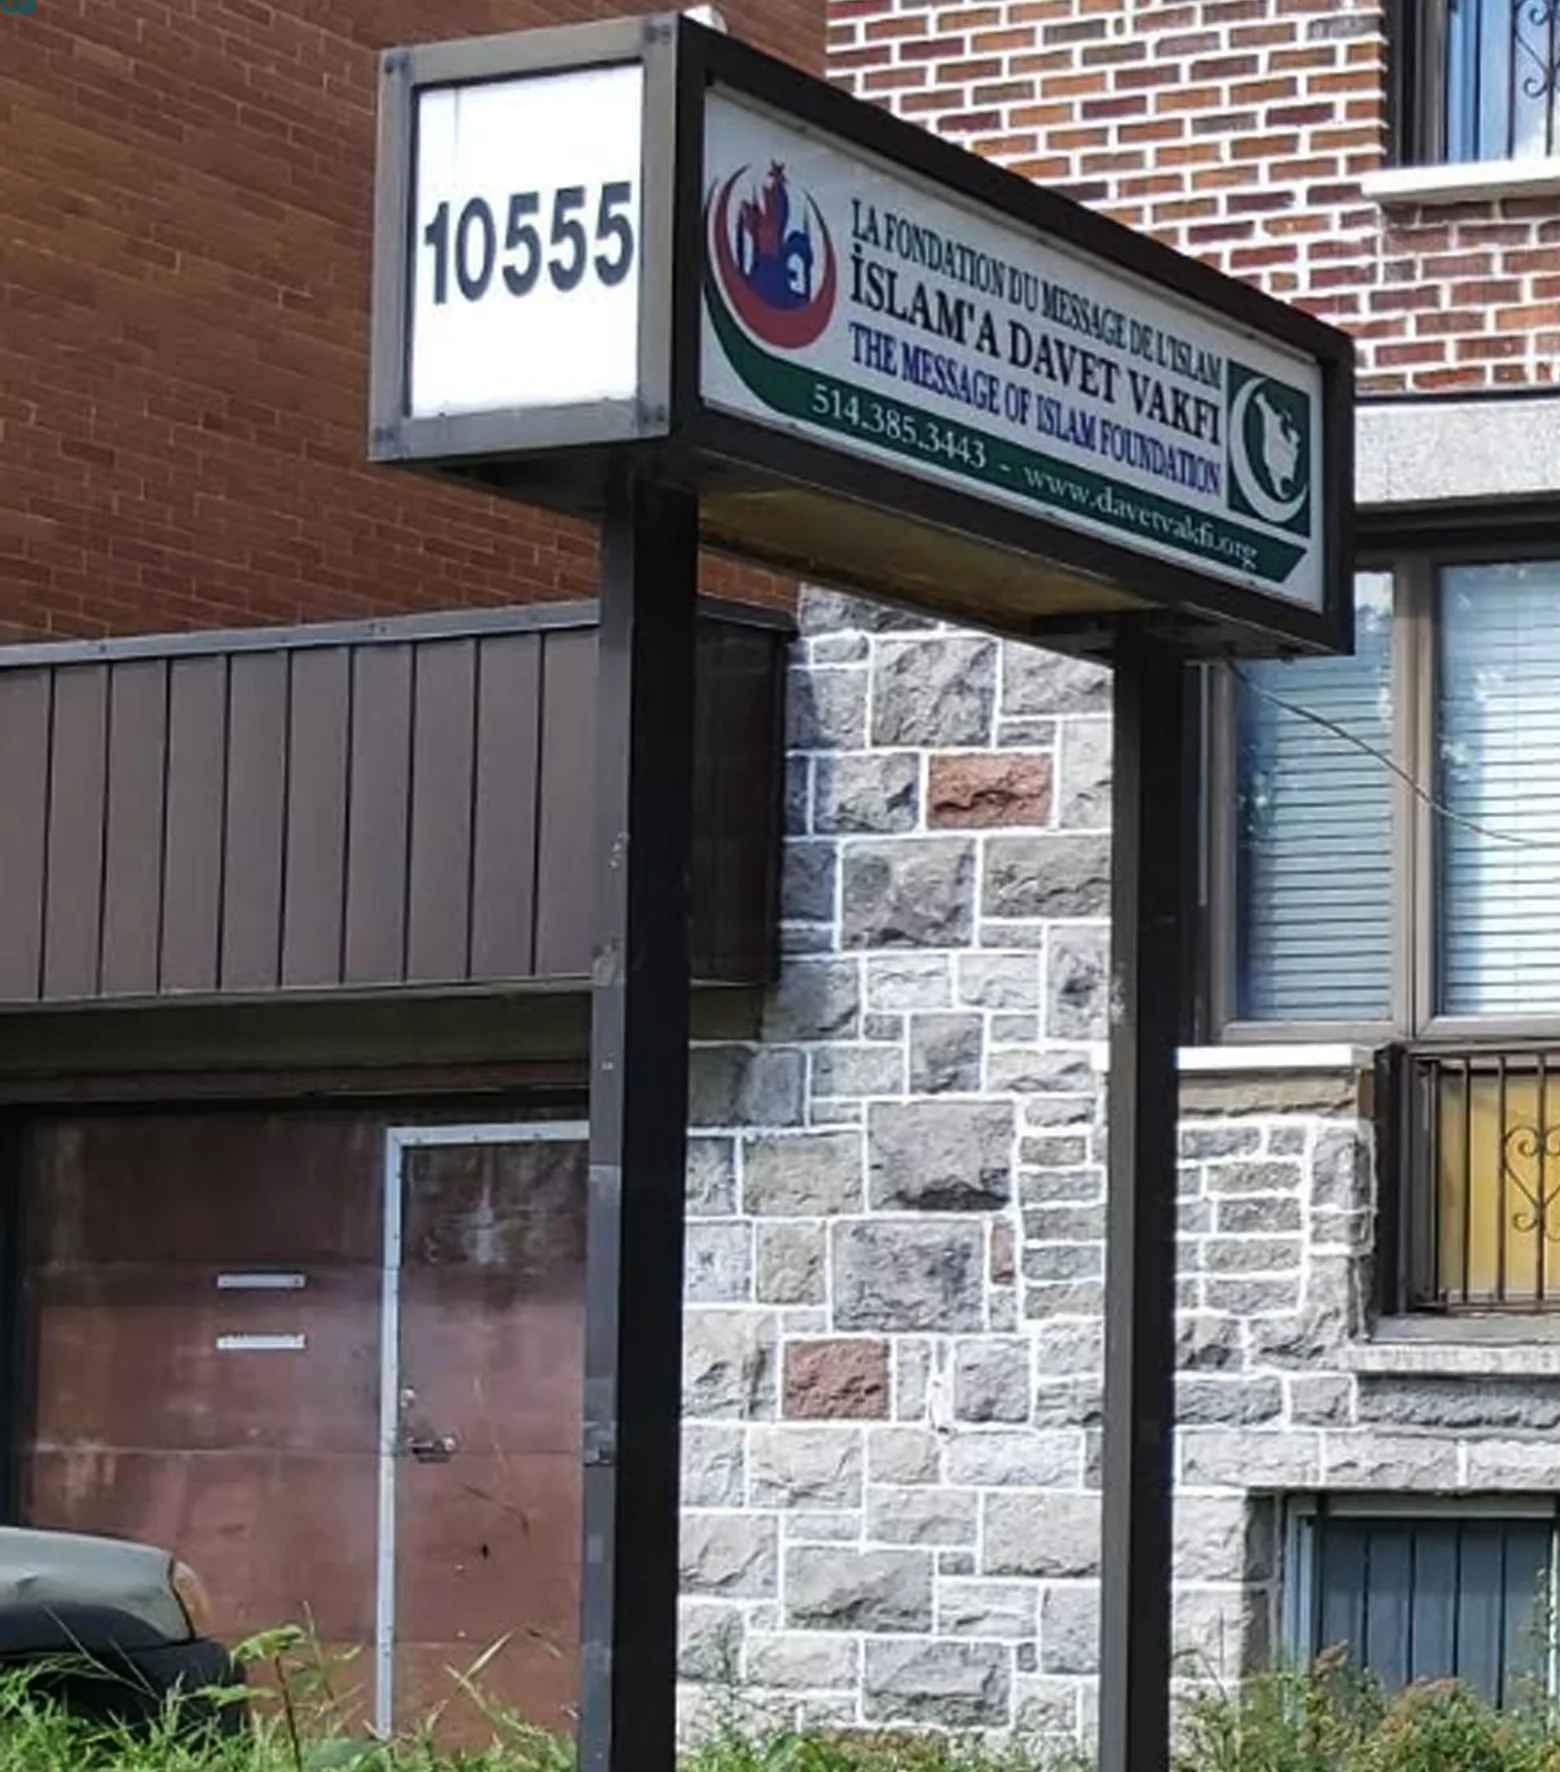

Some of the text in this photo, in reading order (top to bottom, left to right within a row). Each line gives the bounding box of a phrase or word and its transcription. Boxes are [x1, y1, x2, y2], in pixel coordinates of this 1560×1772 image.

[423, 180, 635, 305] 10555
[851, 198, 1222, 391] LA FONDATION DU MESSAGE DE L'ISLAM
[848, 321, 1221, 497] THE MESSAGE OF ISLAM FOUNDATION
[850, 243, 1221, 446] İSLAM'A DAVET VAKFI
[811, 382, 987, 469] 514.385.3443
[1023, 465, 1258, 570] www.davetvakfi.org
